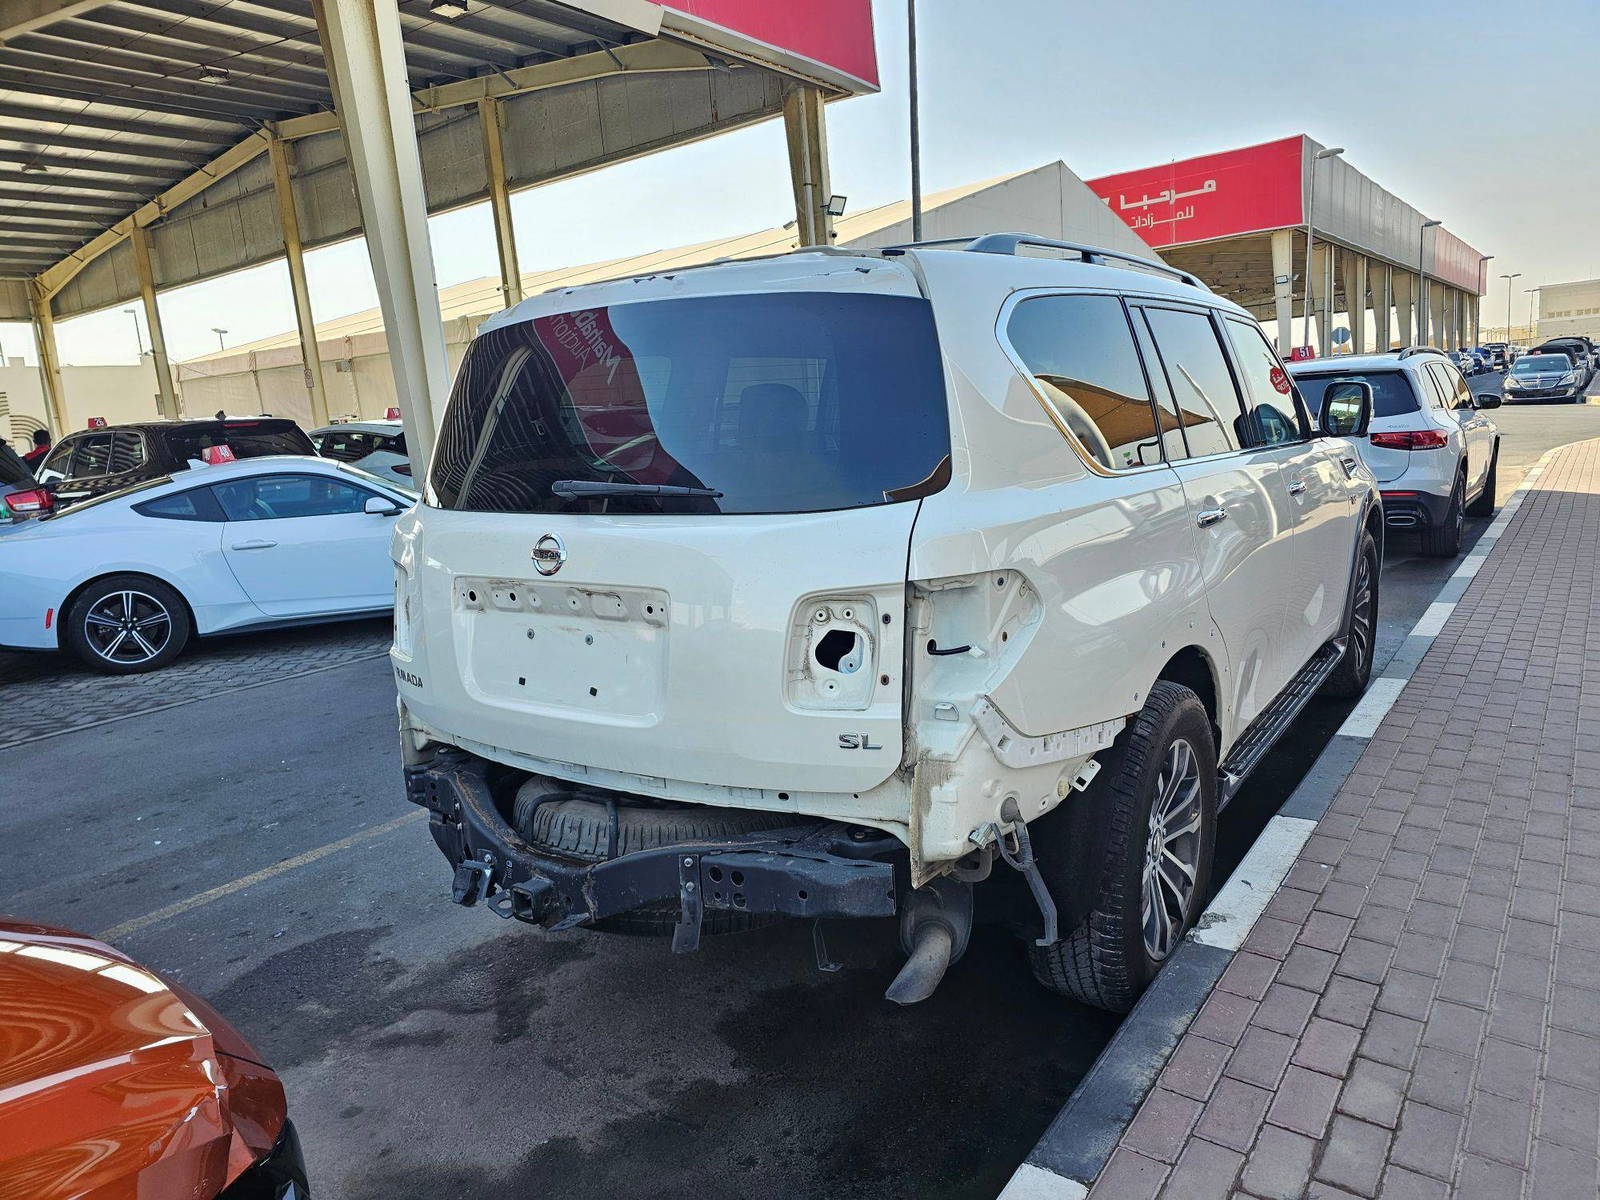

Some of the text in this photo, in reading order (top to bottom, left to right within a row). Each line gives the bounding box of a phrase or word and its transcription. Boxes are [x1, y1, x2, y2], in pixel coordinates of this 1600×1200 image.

[1120, 179, 1216, 210] مرحبا
[1129, 206, 1194, 229] للمزادات
[1299, 349, 1311, 358] 51
[839, 733, 883, 750] SL
